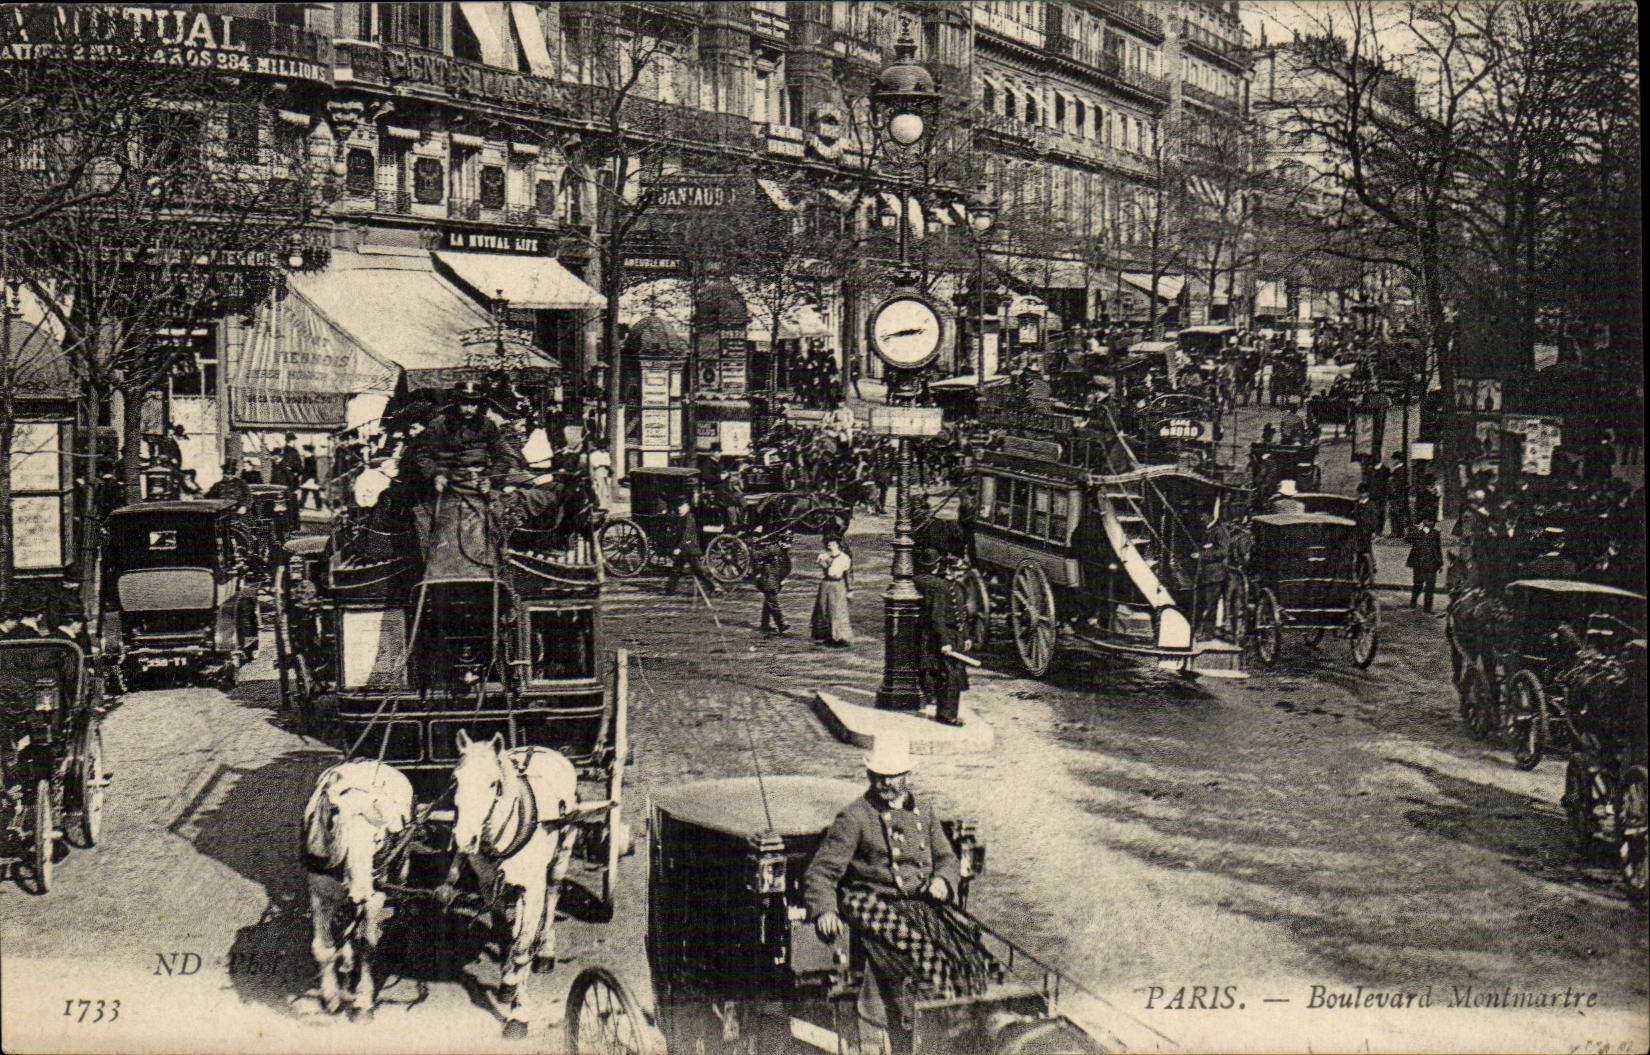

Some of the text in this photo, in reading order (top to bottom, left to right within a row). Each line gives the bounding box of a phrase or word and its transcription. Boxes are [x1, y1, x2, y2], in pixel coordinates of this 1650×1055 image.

[256, 56, 327, 82] MILLIONS
[450, 233, 538, 252] LA MUTUAL LIFE
